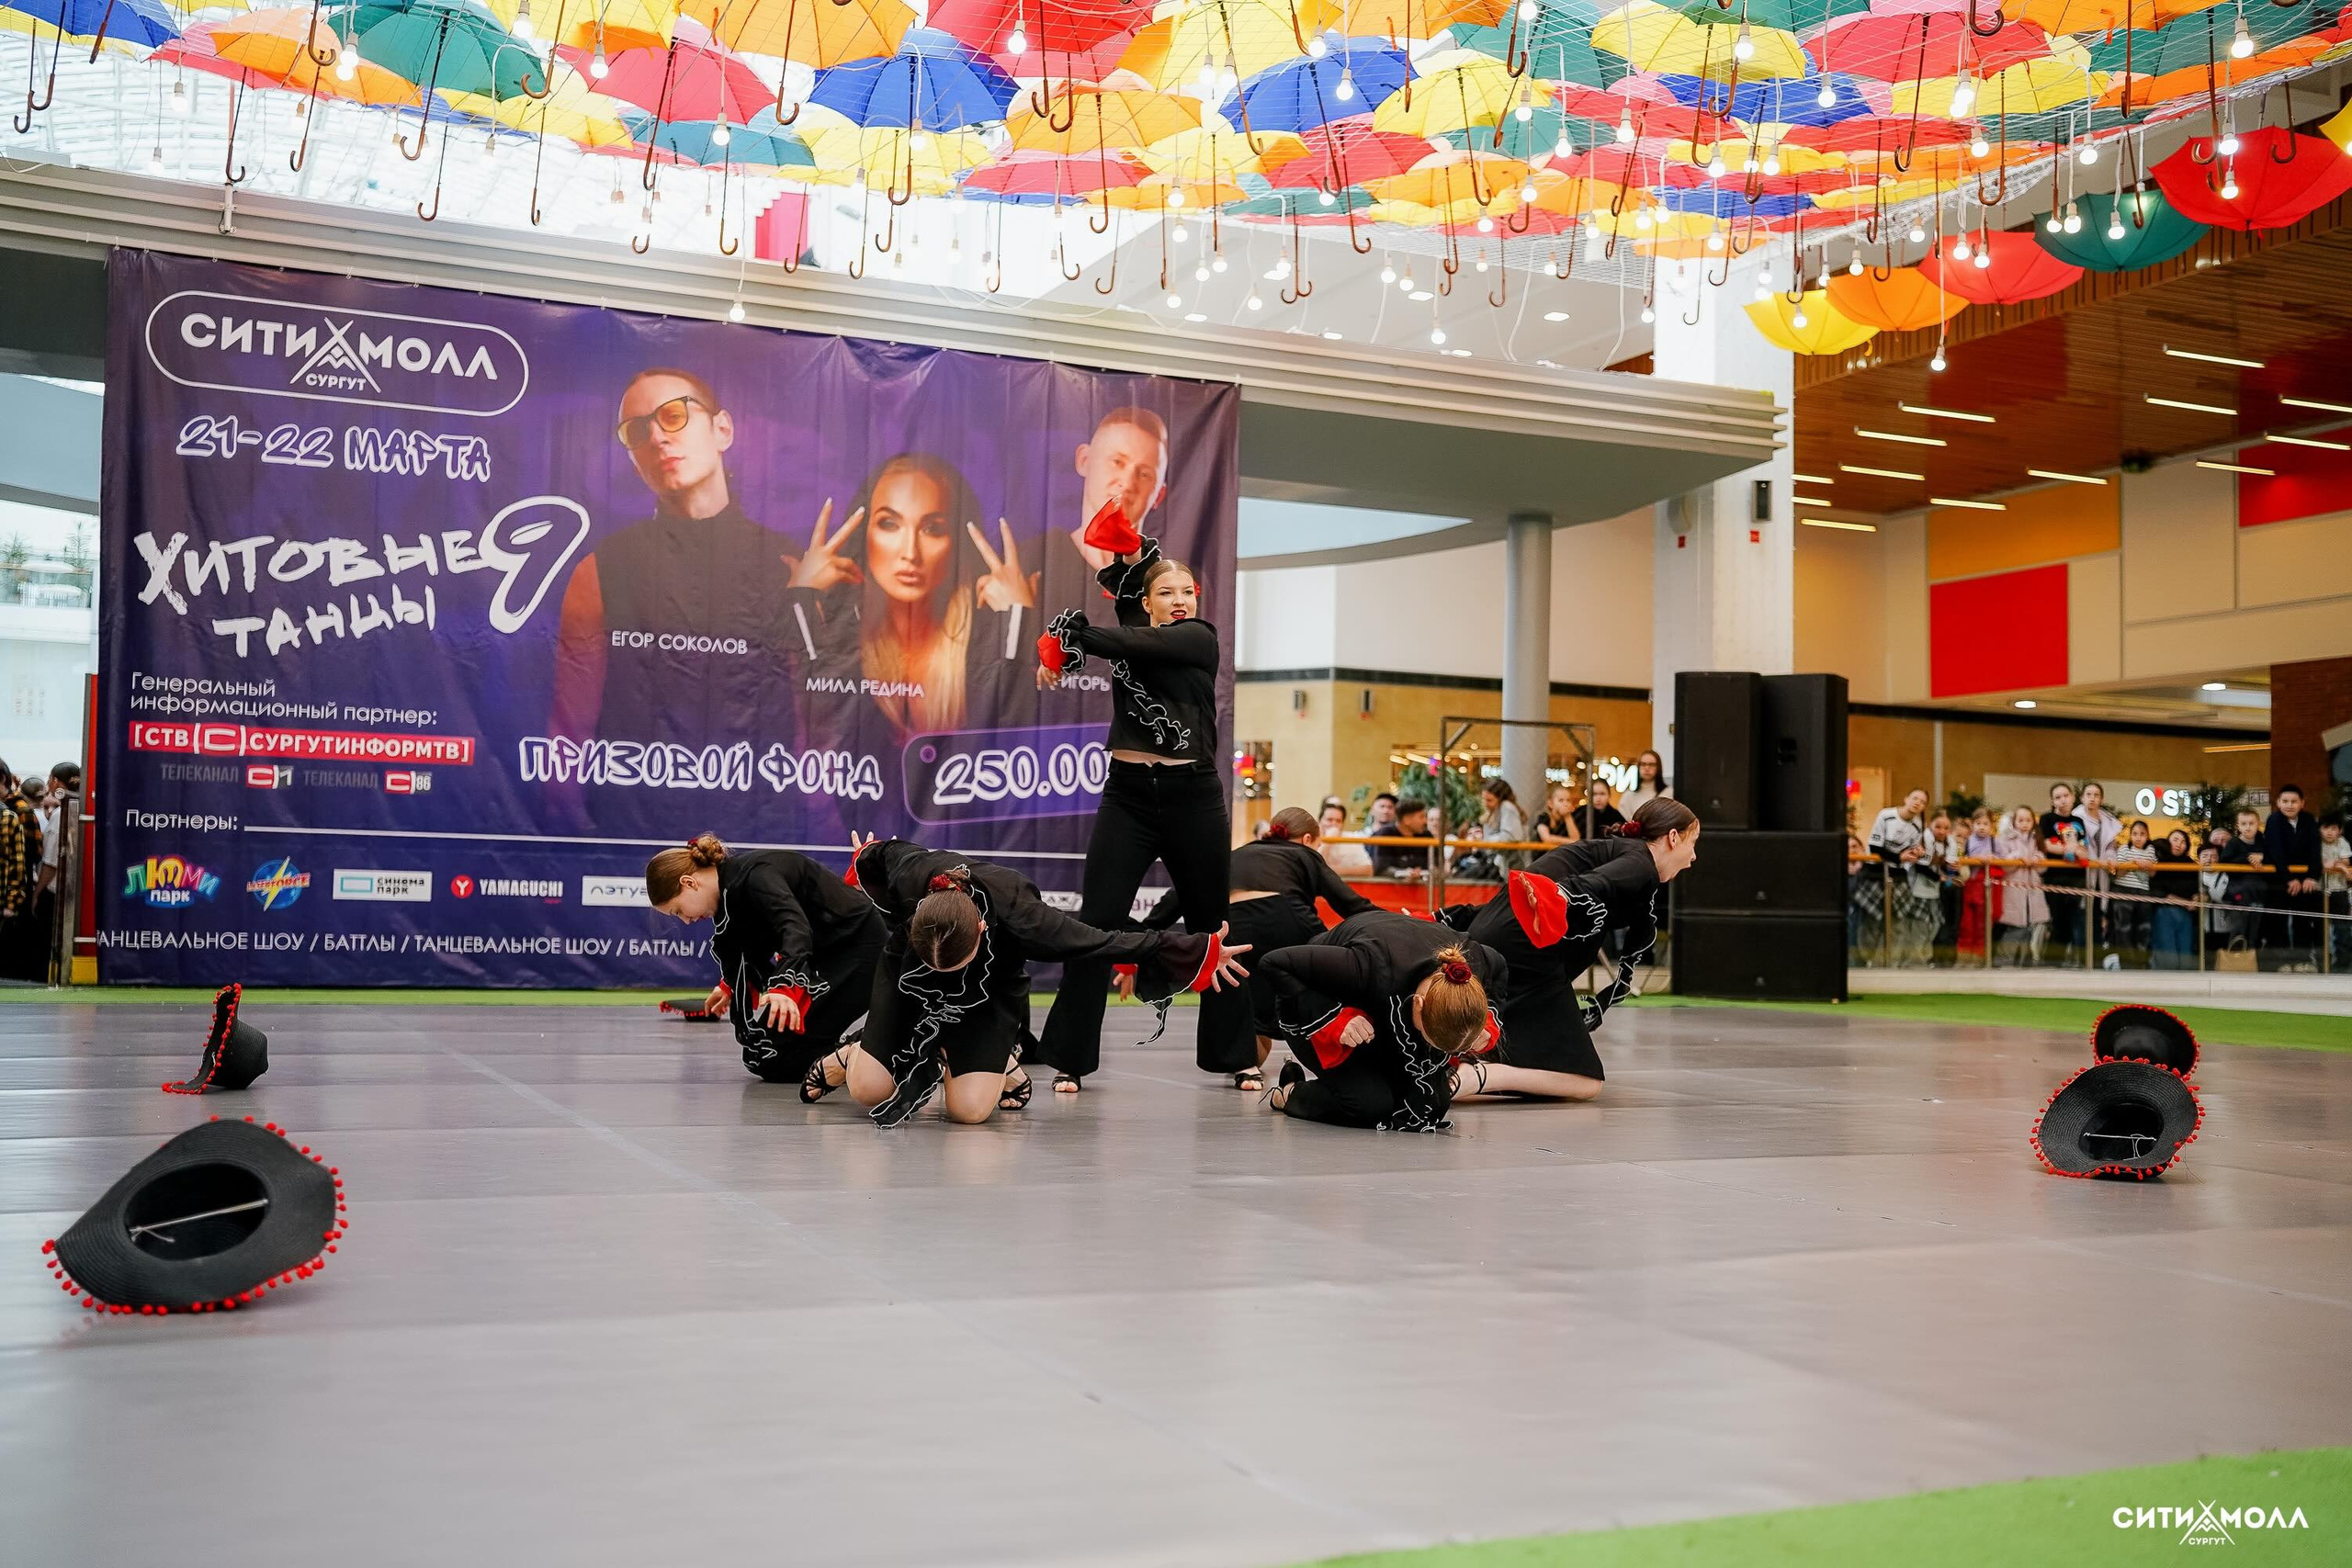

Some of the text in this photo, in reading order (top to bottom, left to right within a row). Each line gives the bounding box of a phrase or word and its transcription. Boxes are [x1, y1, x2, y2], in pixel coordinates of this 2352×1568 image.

[180, 312, 499, 381] СИТИ МОЛЛ
[304, 372, 368, 392] СУРГУТ
[175, 414, 492, 483] 21-22 МАРТА
[212, 583, 436, 658] ТАНЦЫ
[611, 629, 749, 656] ЕГОР СОКОЛОВ
[131, 671, 277, 698] Генеральный
[806, 676, 925, 699] МИЛА РЕДИНА
[1060, 674, 1111, 692] ИГОРЬ
[130, 692, 438, 728] информационный партнер:
[160, 763, 240, 784] ТЕЛЕКАНАЛ
[303, 770, 379, 790] ТЕЛЕКАНАЛ
[518, 735, 885, 801] ПРИЗОВОЙ ФОНД
[125, 808, 239, 833] Партнеры:
[150, 889, 191, 906] парк
[376, 886, 409, 897] парк
[479, 878, 565, 897] YAMAGUCHI
[97, 930, 248, 950] АНЦЕВАЛЬНОЕ
[254, 931, 305, 951] ШОУ
[324, 933, 396, 952] БАТТЛЫ
[413, 934, 561, 954] ТАНЦЕВАЛЬНОЕ
[565, 937, 613, 956] ШОУ
[629, 938, 695, 956] БАТТЛЫ
